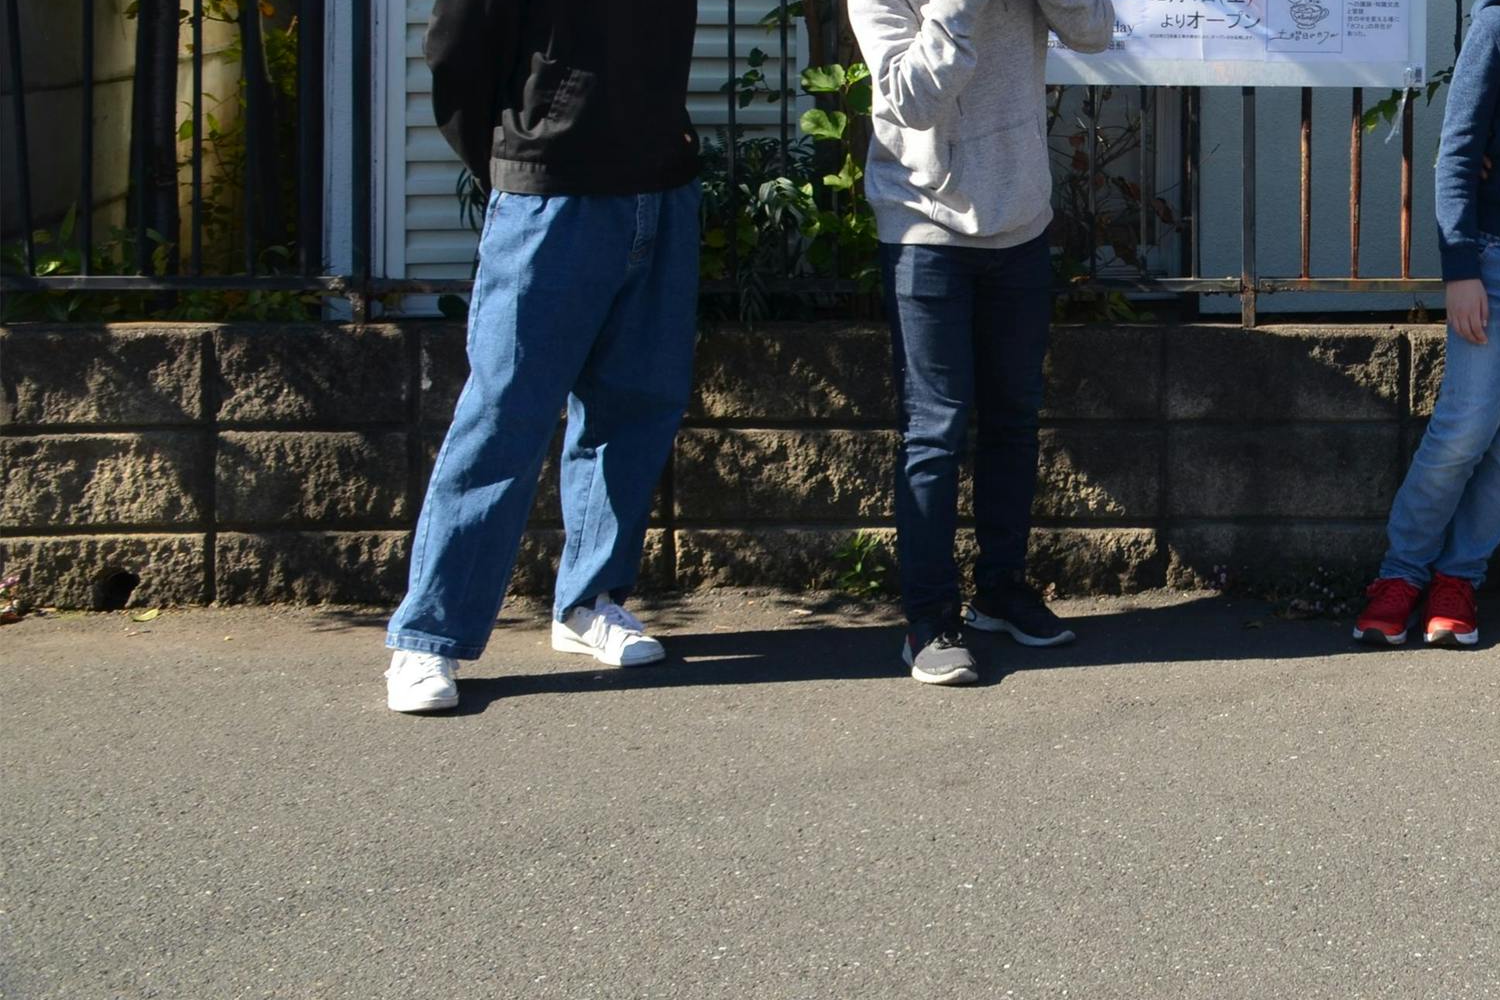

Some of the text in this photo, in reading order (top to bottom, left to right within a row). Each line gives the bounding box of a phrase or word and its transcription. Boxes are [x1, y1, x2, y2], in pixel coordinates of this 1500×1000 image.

[1160, 11, 1261, 29] よりオープン
